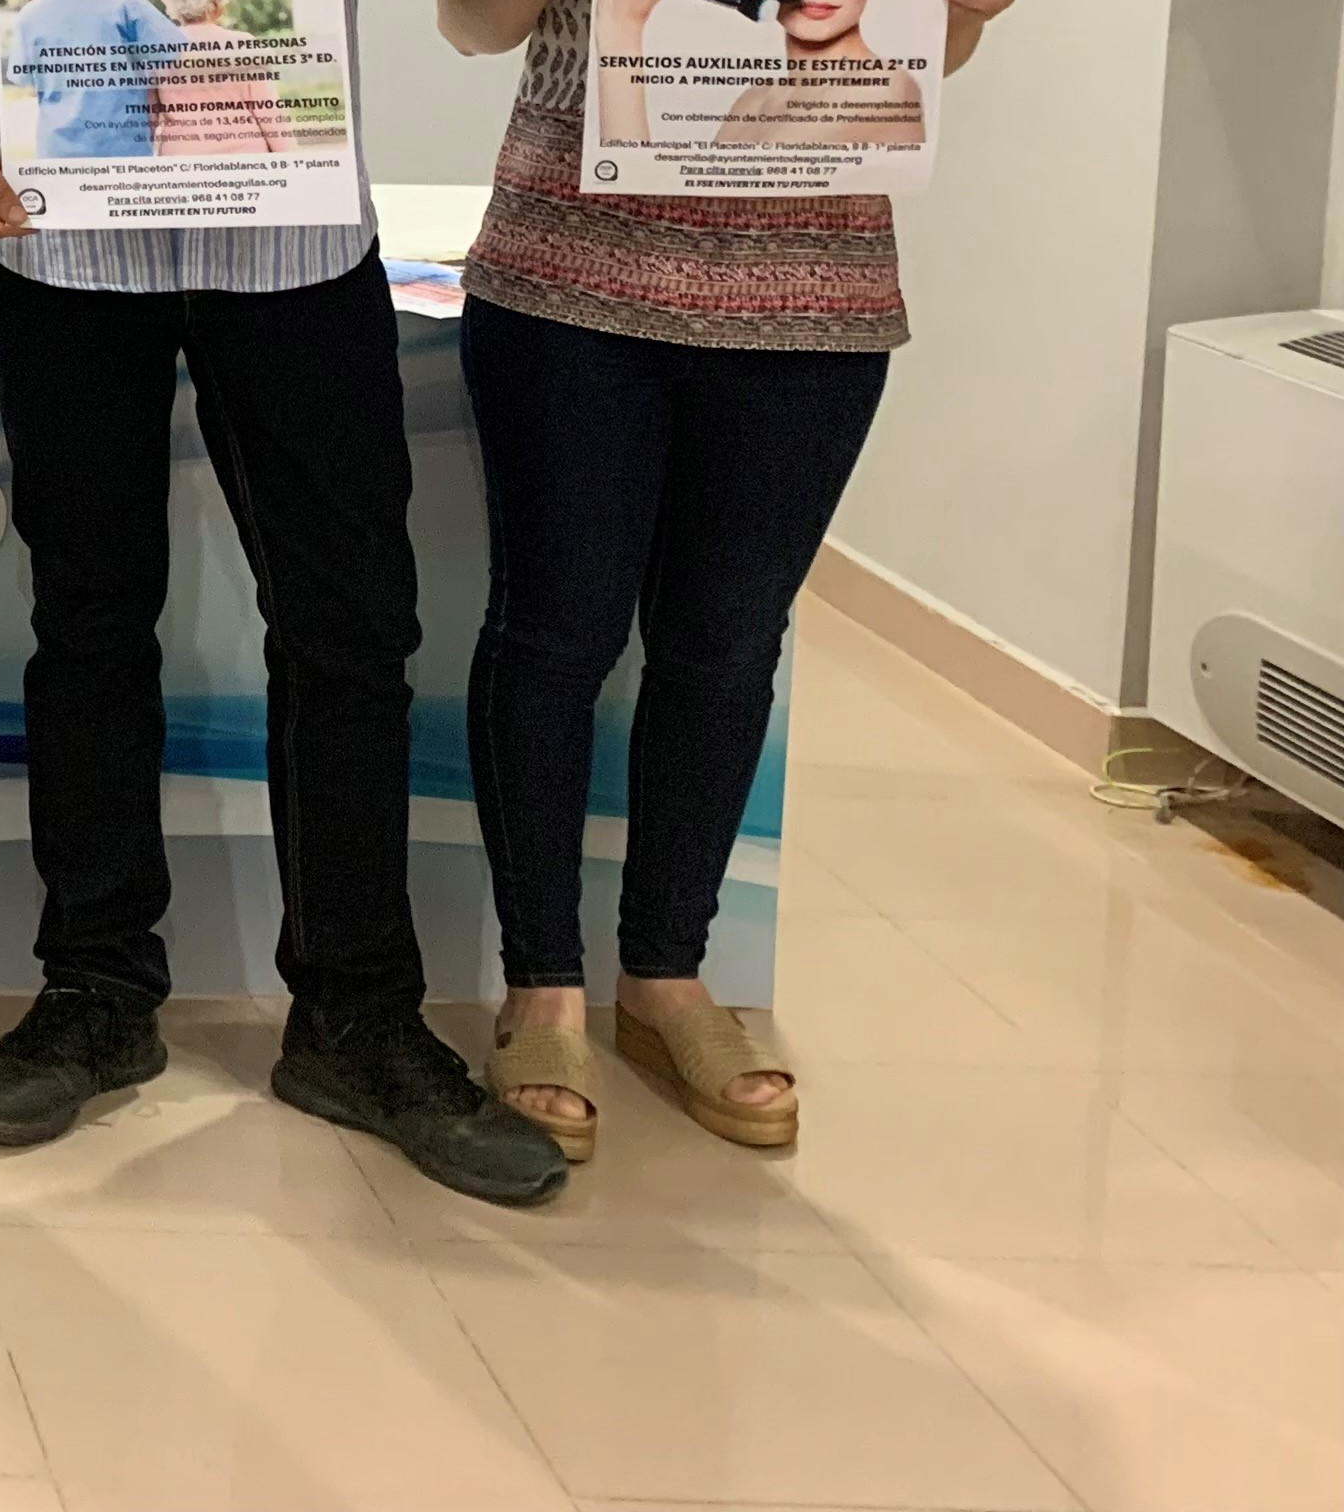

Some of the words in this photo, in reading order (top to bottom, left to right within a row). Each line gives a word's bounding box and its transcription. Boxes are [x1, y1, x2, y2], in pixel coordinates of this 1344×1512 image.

[38, 44, 106, 57] ATENCIÓN
[109, 39, 221, 55] SOCIOSANITARIA
[224, 40, 234, 50] A
[237, 35, 307, 49] PERSONAS
[12, 62, 107, 74] DEPENDIENTES
[110, 61, 127, 71] EN
[130, 57, 231, 70] INSTITUCIONES
[234, 54, 297, 66] SOCIALES
[599, 55, 682, 68] SERVICIOS
[685, 57, 782, 70] AUXILIARES
[786, 58, 807, 71] DE
[811, 57, 883, 71] ESTÉTICA
[907, 58, 927, 70] ED
[199, 99, 274, 112] FORMATIVO
[274, 97, 339, 108] GRATUITO
